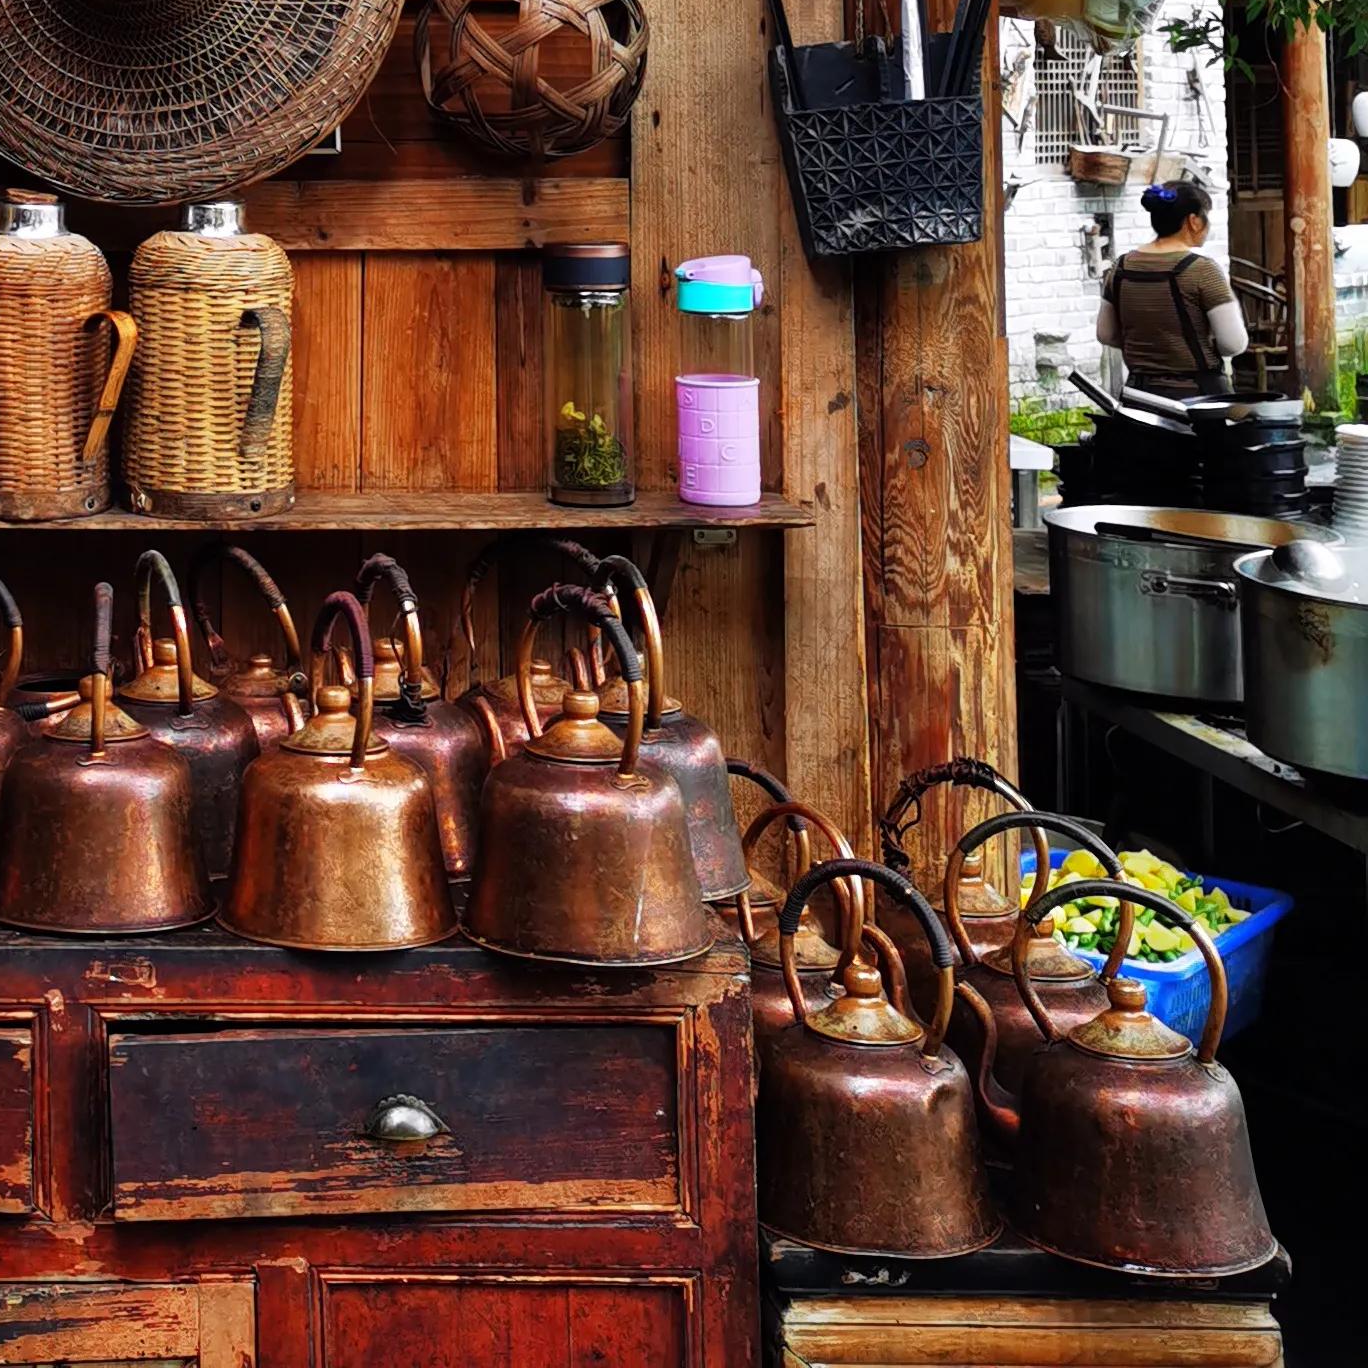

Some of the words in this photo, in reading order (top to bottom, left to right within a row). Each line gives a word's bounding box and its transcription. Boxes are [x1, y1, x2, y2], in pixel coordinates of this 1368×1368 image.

[700, 418, 715, 433] D
[721, 444, 737, 462] C
[686, 465, 697, 488] E
